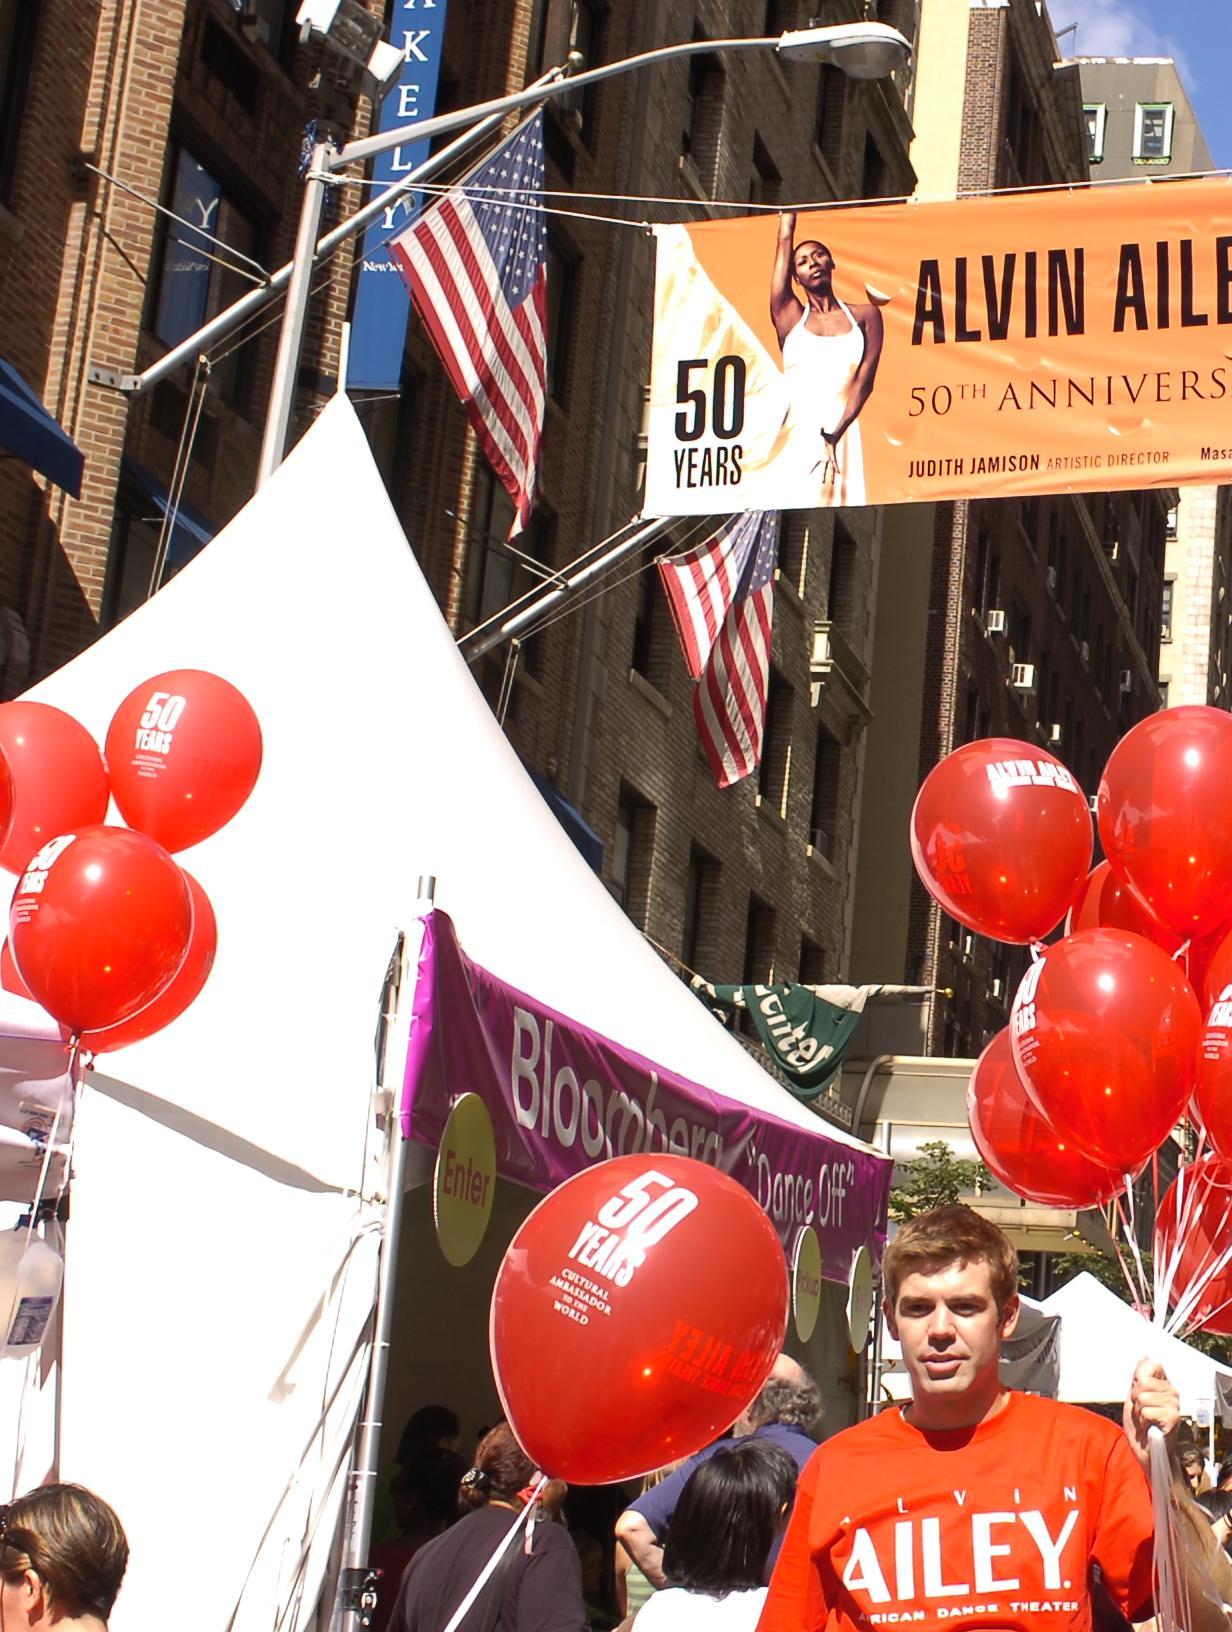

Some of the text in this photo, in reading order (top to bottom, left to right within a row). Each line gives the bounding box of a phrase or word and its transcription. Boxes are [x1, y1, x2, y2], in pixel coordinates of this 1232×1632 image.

[911, 246, 1085, 346] ALVIN
[674, 354, 748, 443] 50
[908, 382, 987, 418] 50TH
[674, 444, 743, 489] YEARS
[908, 449, 1171, 479] JUDITH JAMISON ARTISTIC DIRECTOR
[139, 691, 188, 732] 50
[134, 728, 173, 755] YEARS
[442, 1149, 491, 1209] Enter
[598, 1169, 700, 1250] 50
[567, 1220, 647, 1289] YEARS
[549, 1275, 613, 1316] AMBASSADOR
[561, 1267, 610, 1301] CULTURAL
[553, 1299, 590, 1326] WORLD
[937, 1602, 1000, 1619] DANCE
[1009, 1600, 1080, 1613] THEATER
